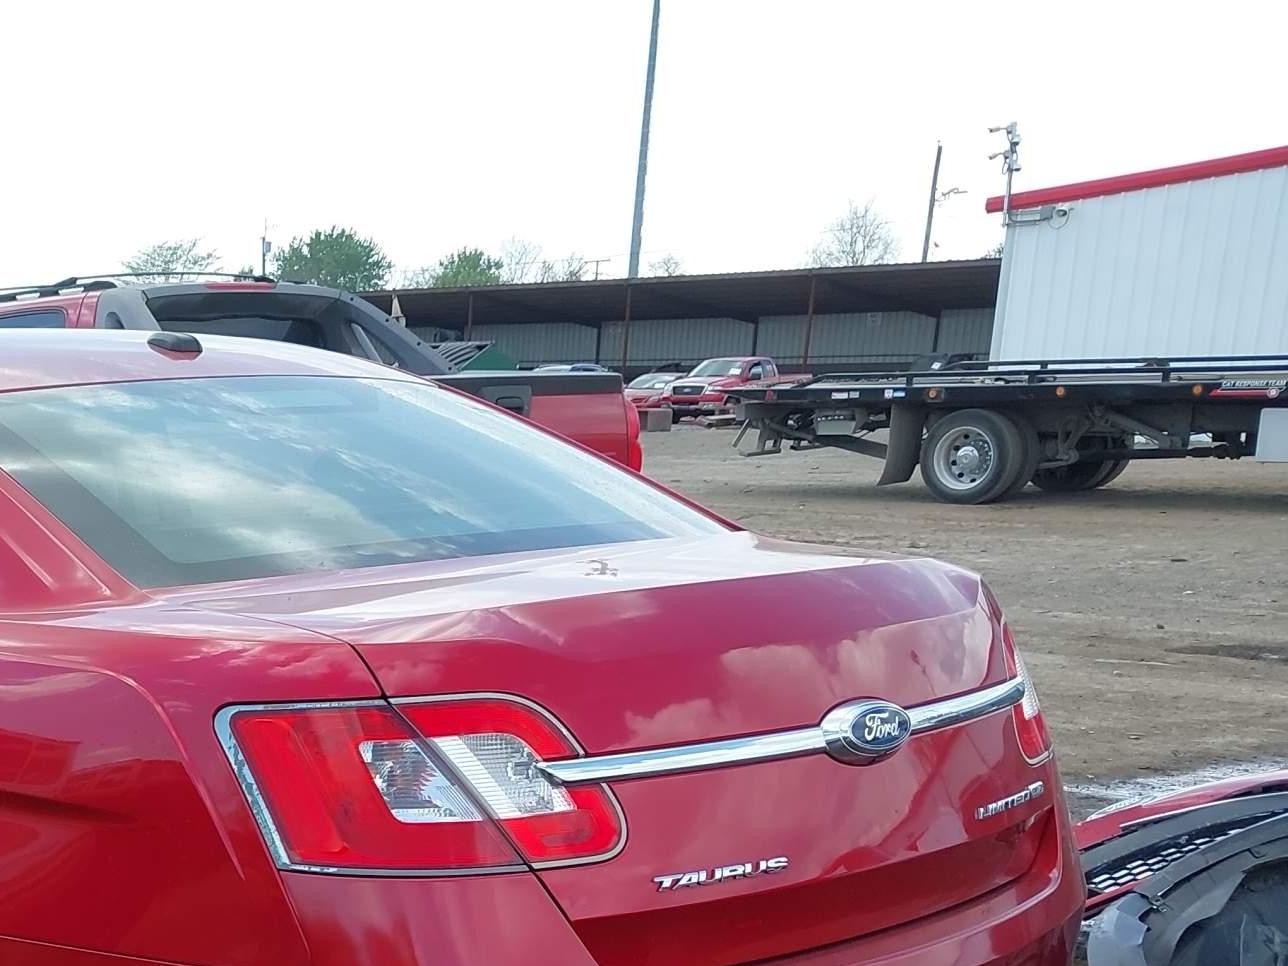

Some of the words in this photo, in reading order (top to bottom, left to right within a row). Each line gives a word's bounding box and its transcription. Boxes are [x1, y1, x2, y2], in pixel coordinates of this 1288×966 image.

[1268, 379, 1287, 387] TEAM
[864, 711, 900, 741] Ford
[974, 780, 1044, 820] LIMITED
[653, 856, 789, 892] TAURUS
